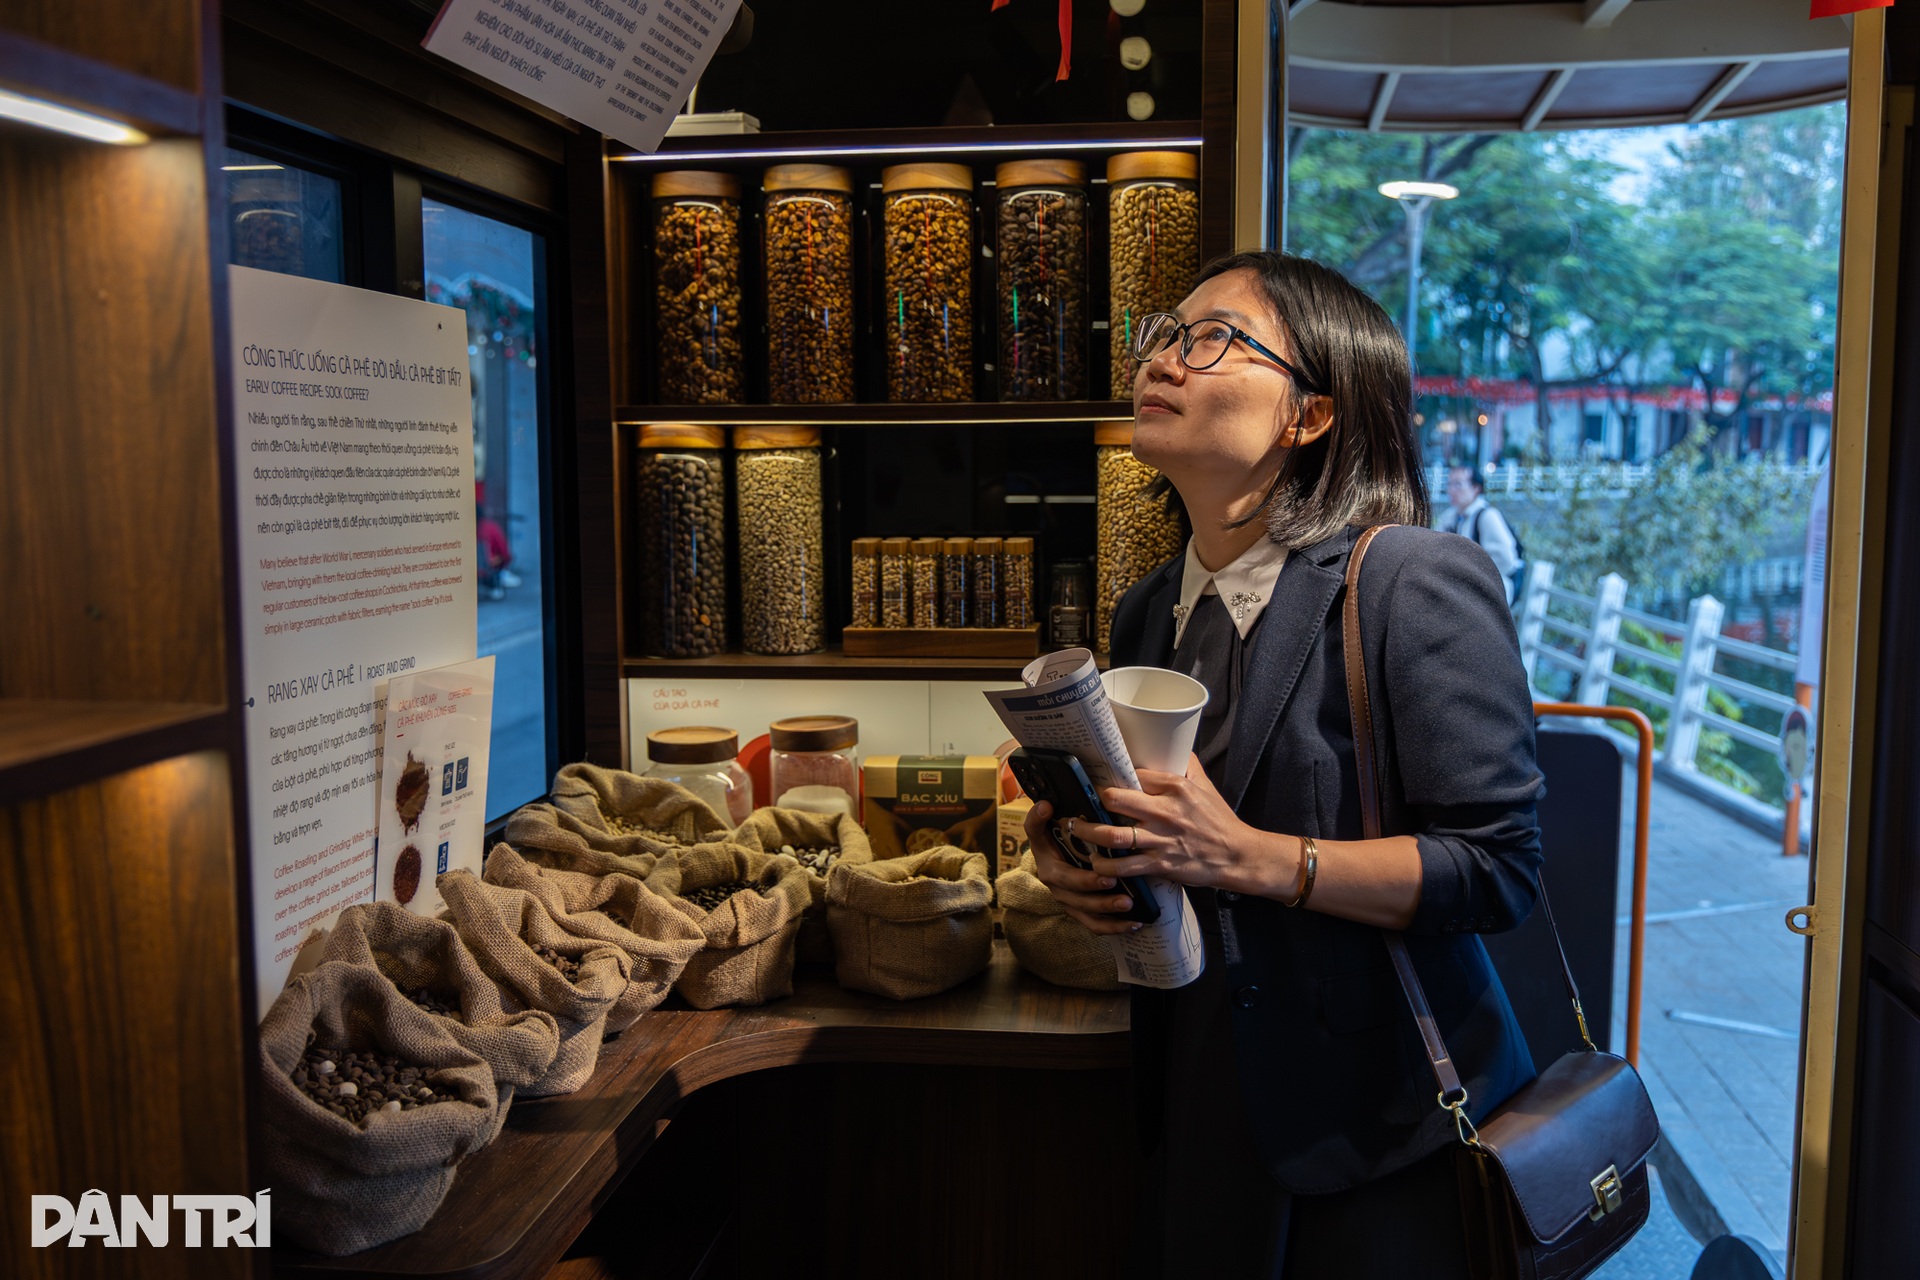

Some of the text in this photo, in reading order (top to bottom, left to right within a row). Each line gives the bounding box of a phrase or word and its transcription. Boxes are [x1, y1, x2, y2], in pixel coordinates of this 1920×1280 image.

[243, 344, 276, 368] CÔNG
[278, 350, 306, 371] THỨC
[308, 351, 336, 374] UỐNG
[339, 355, 352, 374] CÀ
[354, 357, 371, 377] PHÊ
[373, 359, 388, 379] ĐỜI
[390, 360, 408, 381] ĐẦU:
[409, 363, 419, 382] CÀ
[420, 365, 435, 384] PHÊ
[246, 379, 269, 394] EARLY
[271, 381, 299, 396] COFFEE
[325, 385, 343, 399] SOCK
[344, 386, 369, 401] COFFEE?
[268, 663, 355, 703] RANG XAY CÀ PHÊ
[367, 656, 416, 679] ROAST AND GRIND
